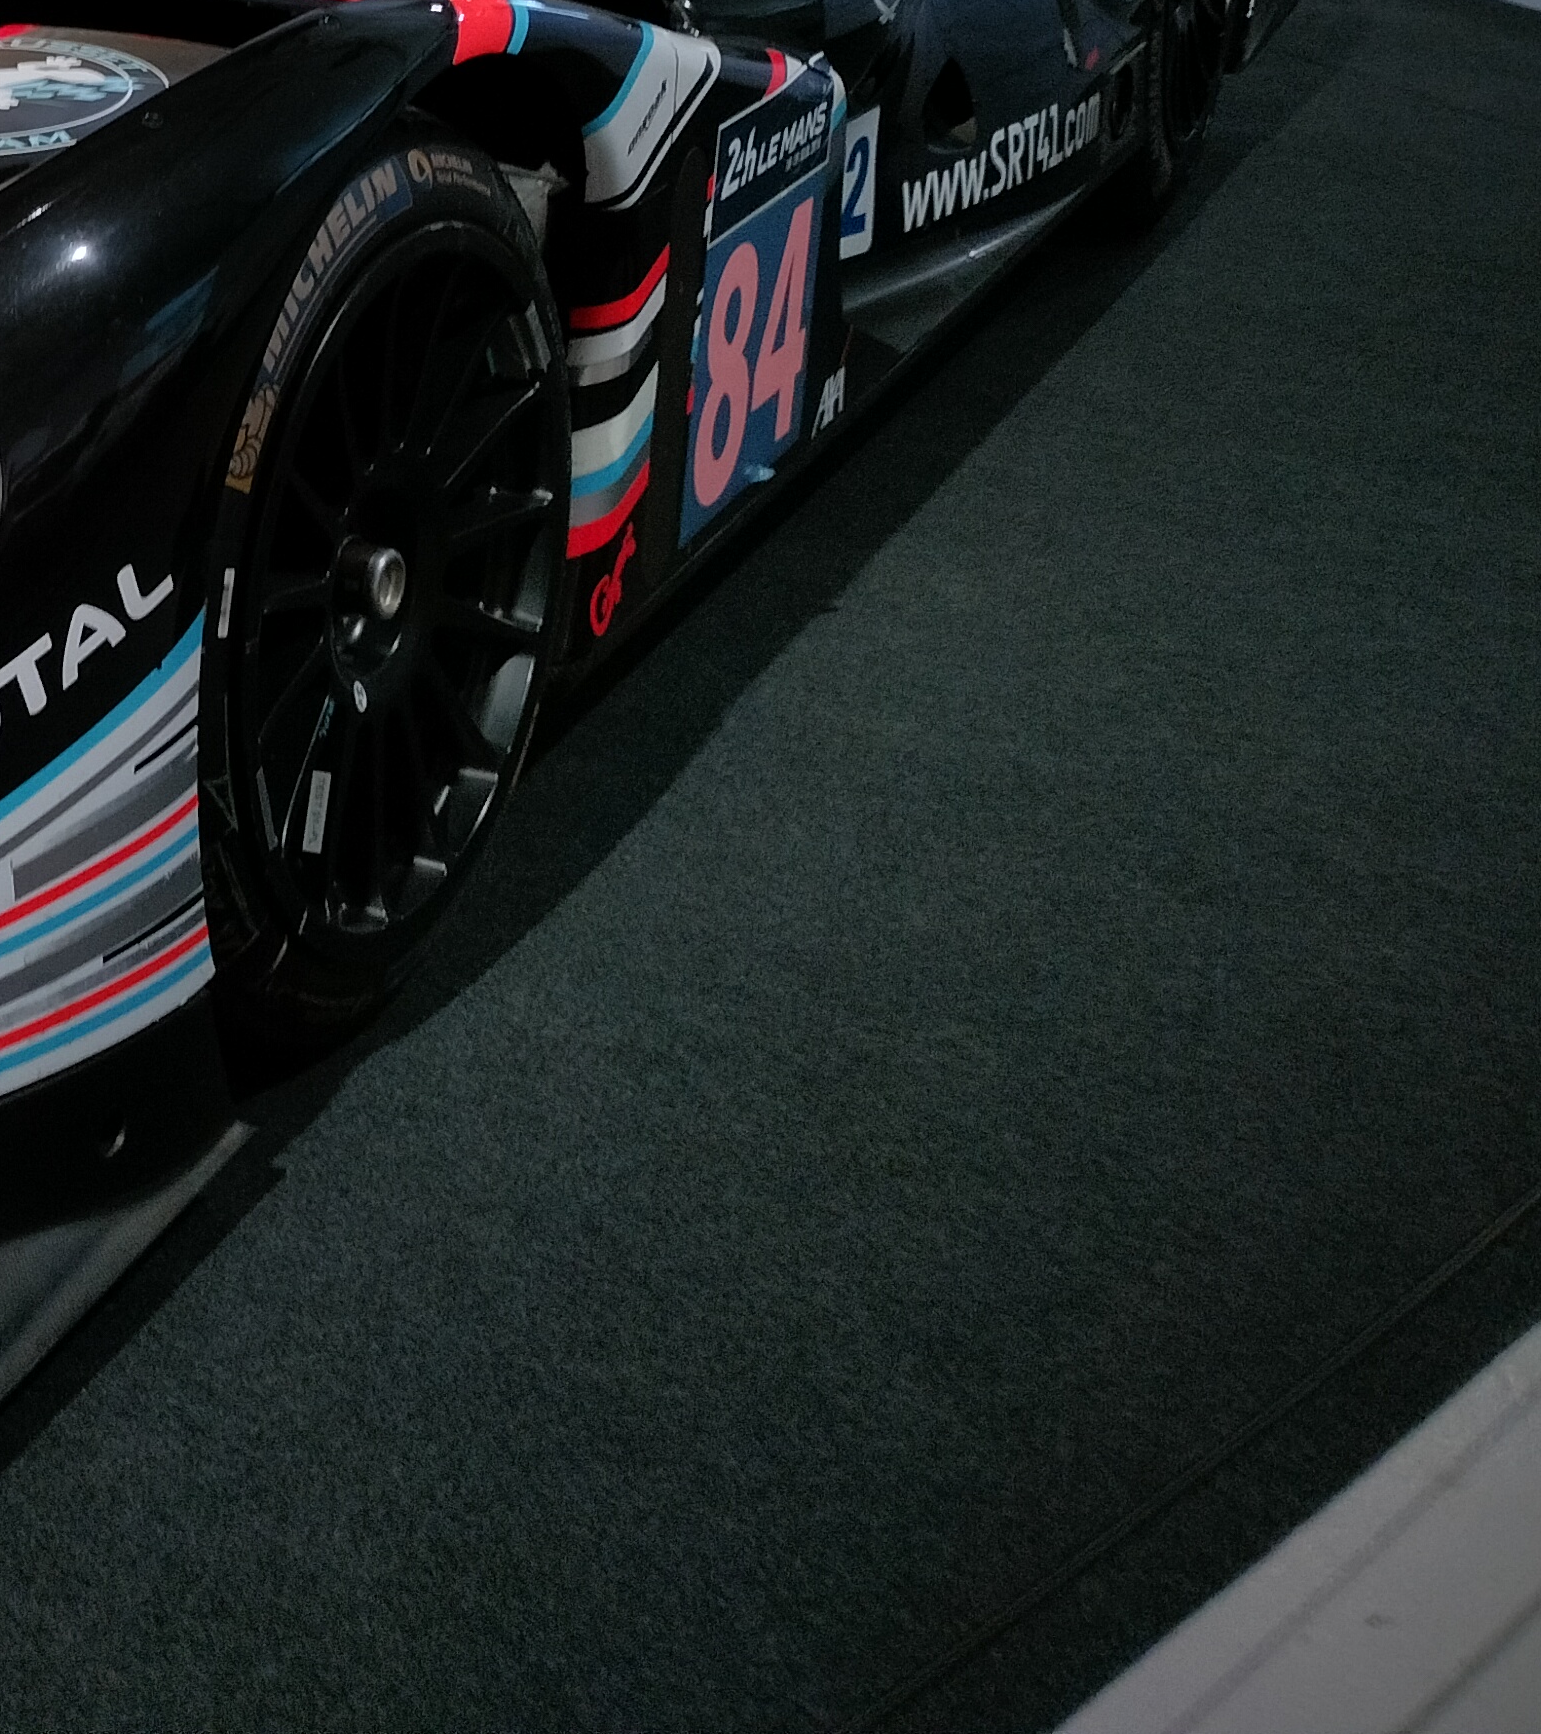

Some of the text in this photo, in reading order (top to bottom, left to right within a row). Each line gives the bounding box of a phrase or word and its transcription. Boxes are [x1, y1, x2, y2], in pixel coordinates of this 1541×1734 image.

[720, 126, 757, 201] 24h
[756, 132, 782, 176] LE
[779, 101, 828, 161] MANS
[841, 136, 870, 238] 2
[262, 163, 399, 374] MICHELIN
[693, 196, 813, 507] 84
